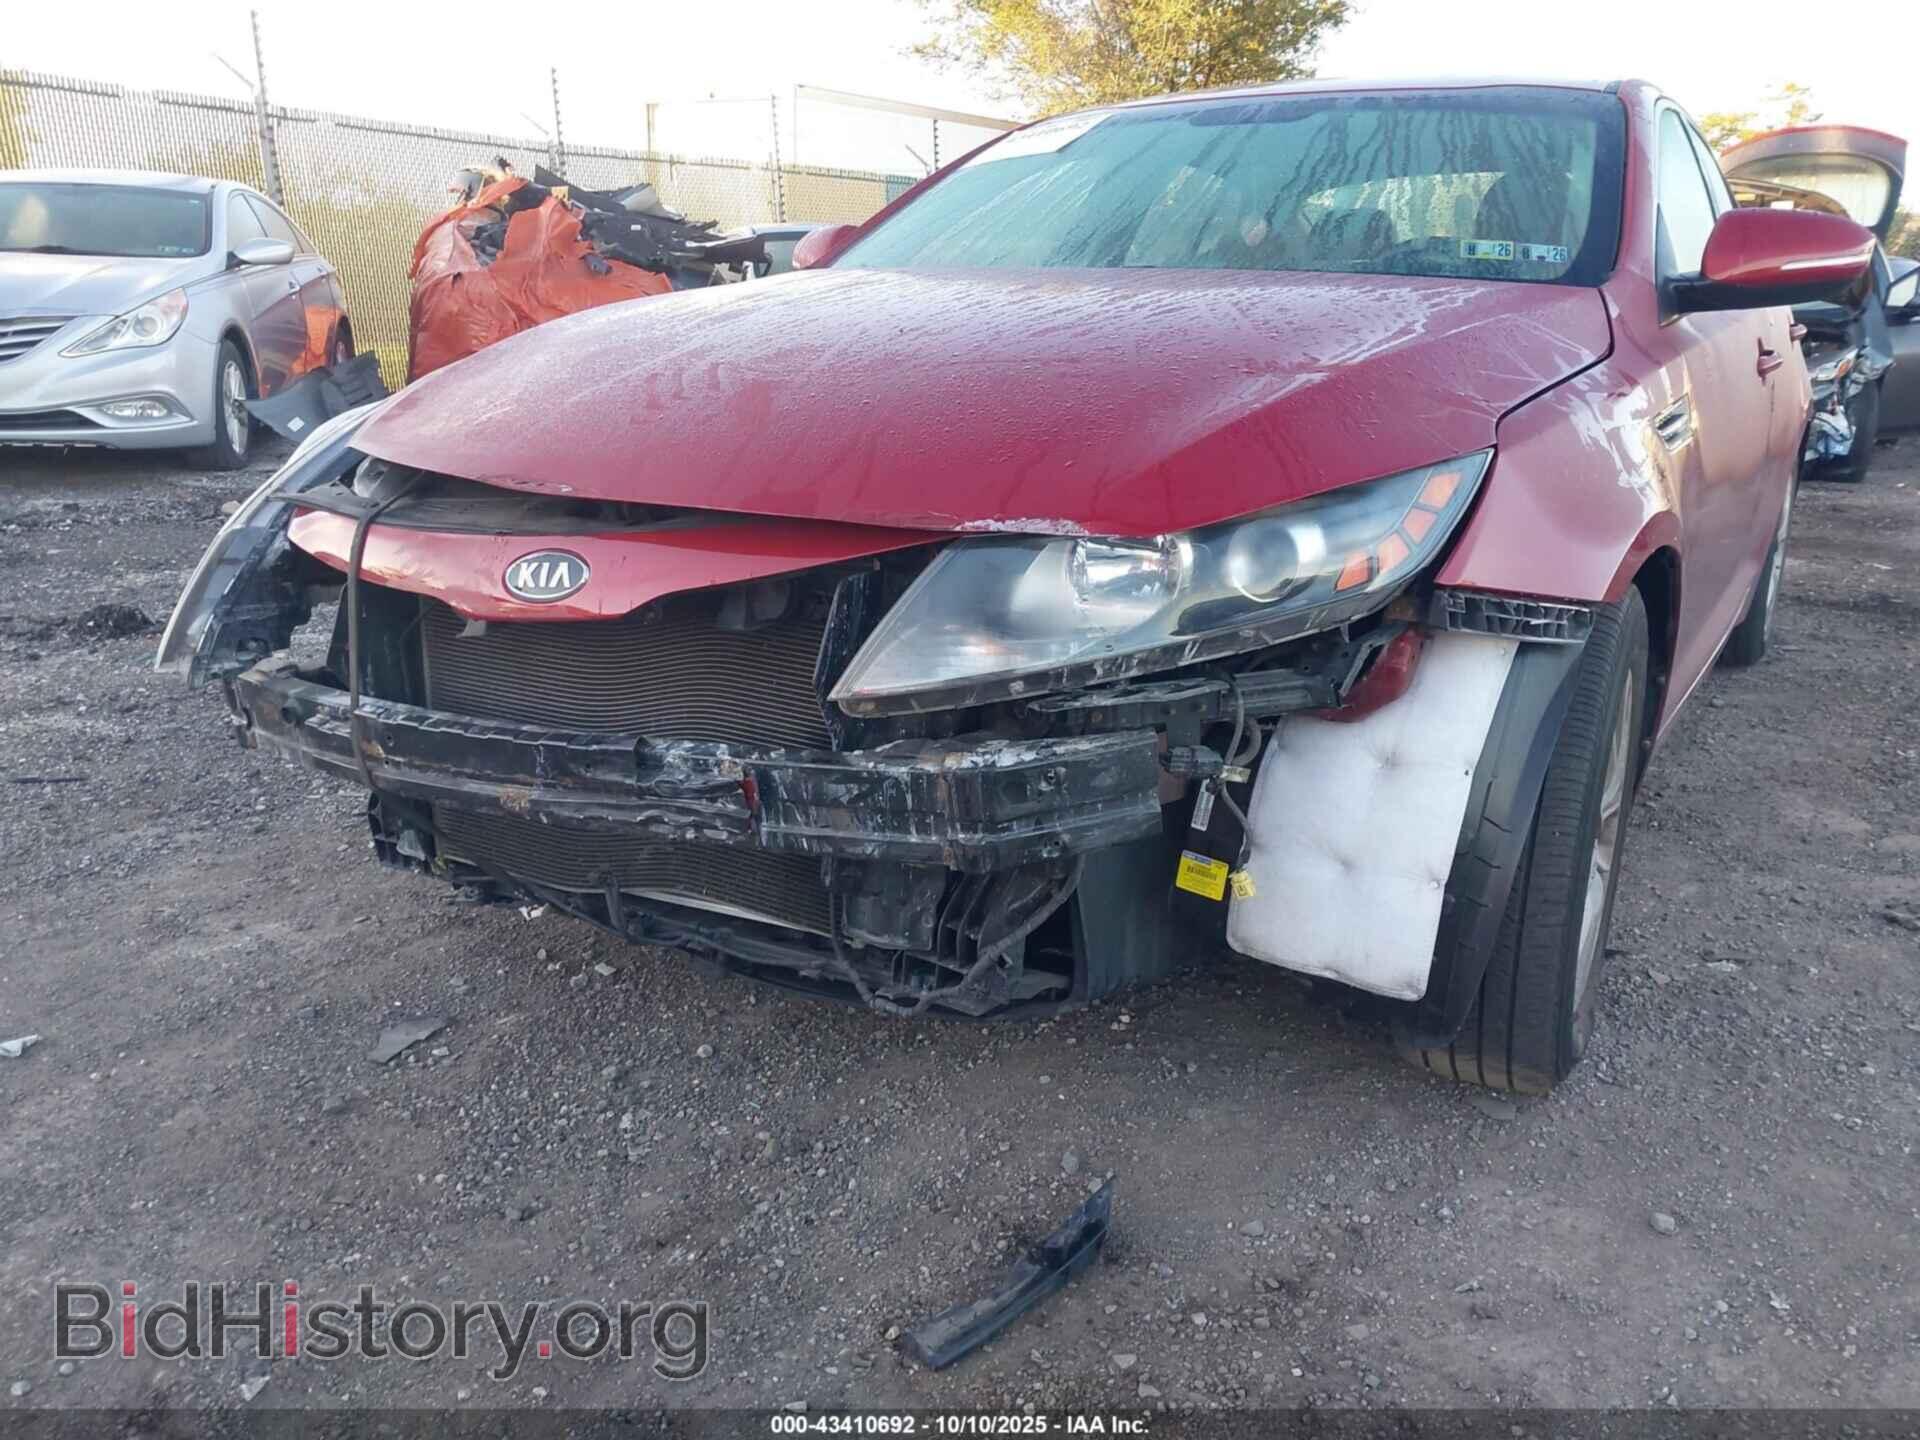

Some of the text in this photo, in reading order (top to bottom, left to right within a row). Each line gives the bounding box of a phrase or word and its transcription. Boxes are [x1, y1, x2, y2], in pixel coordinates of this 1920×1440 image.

[1497, 243, 1512, 257] 26
[1552, 247, 1566, 261] 26
[518, 562, 571, 588] KIA
